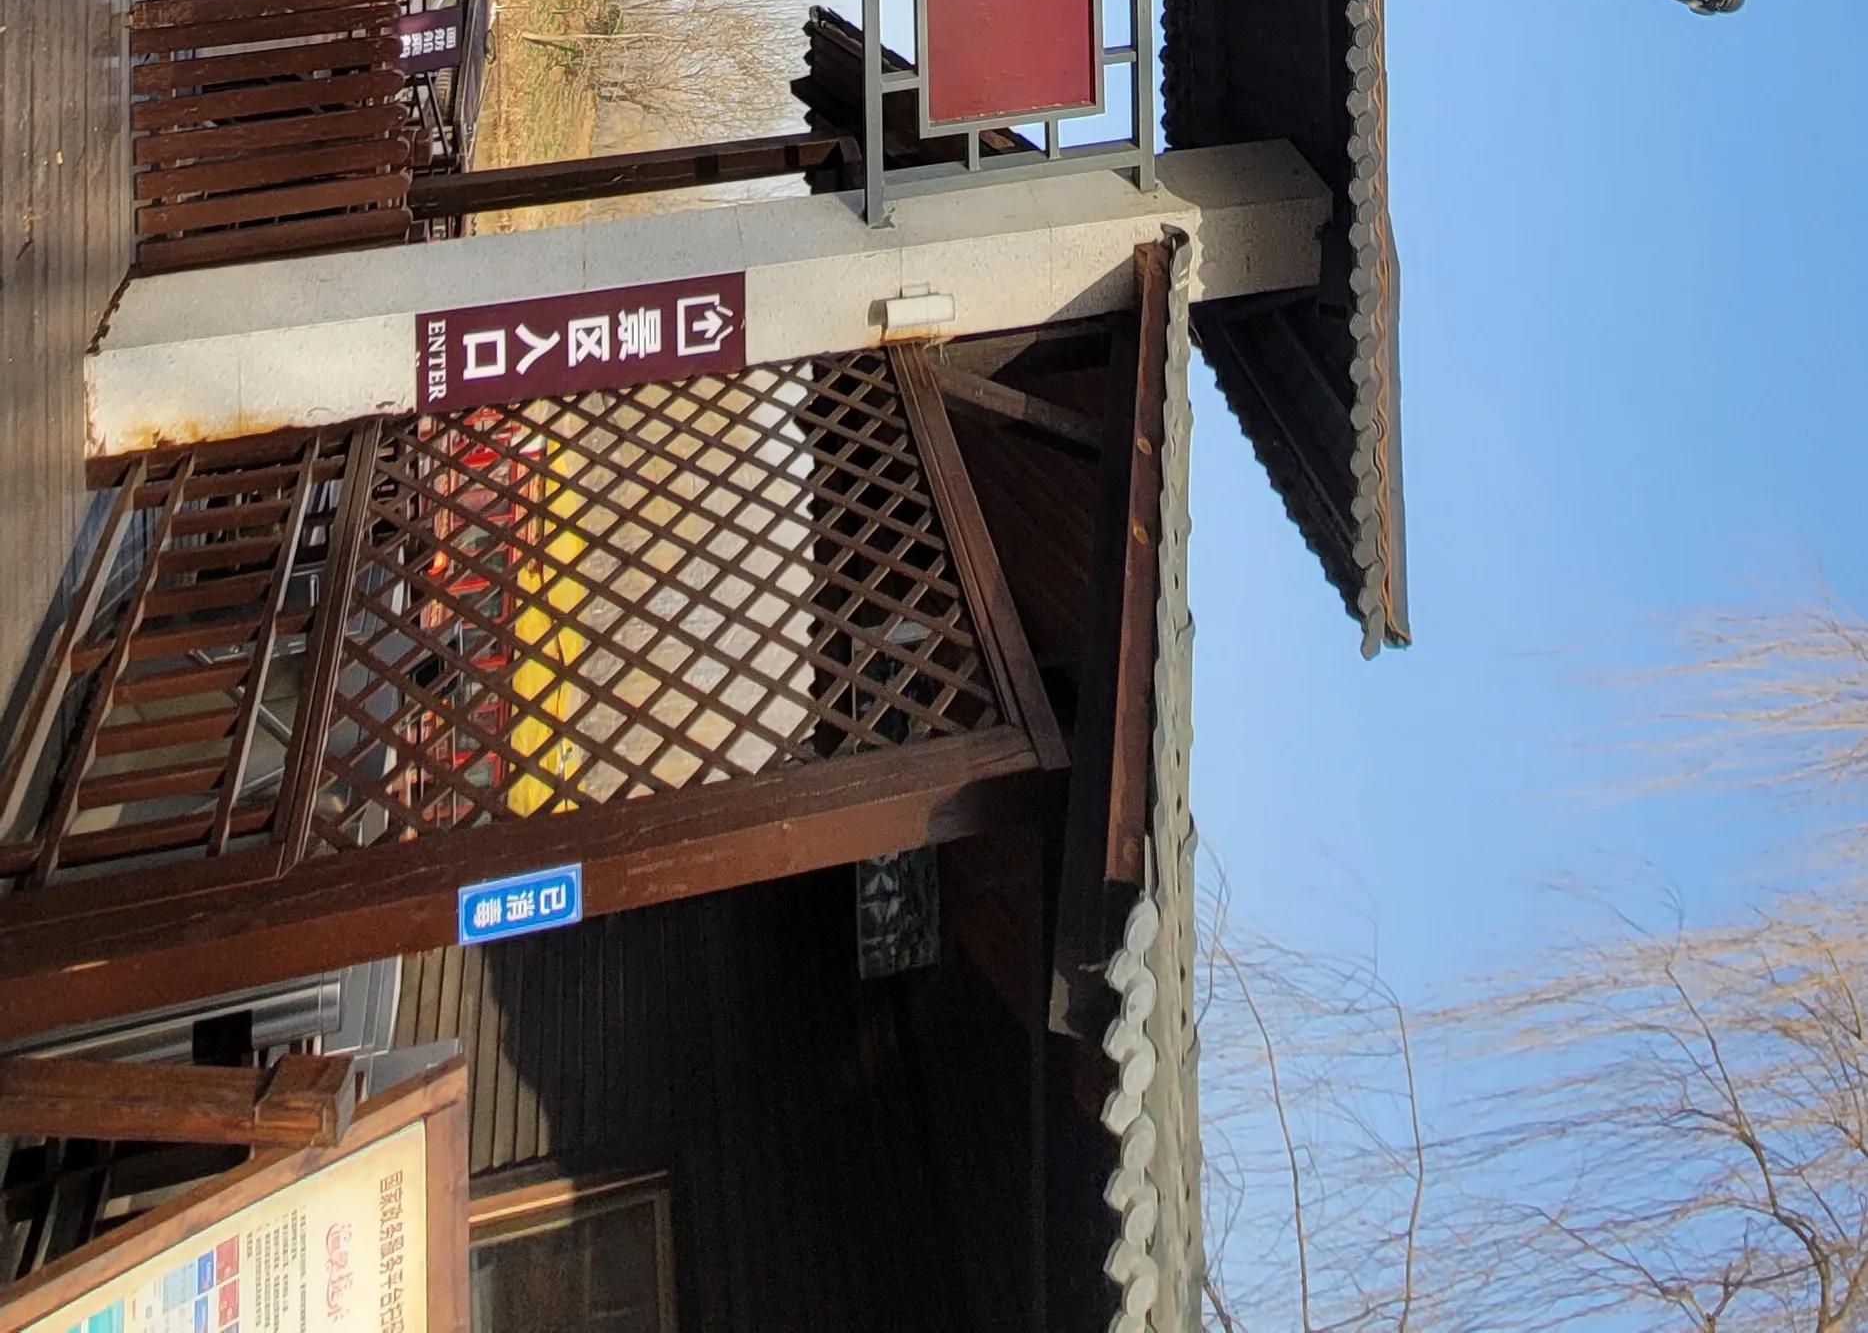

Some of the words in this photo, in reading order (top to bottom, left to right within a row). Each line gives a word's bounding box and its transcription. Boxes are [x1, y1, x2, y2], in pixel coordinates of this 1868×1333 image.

[427, 320, 446, 402] ENTER
[462, 306, 661, 381] 景区入口
[473, 883, 567, 928] 已消毒
